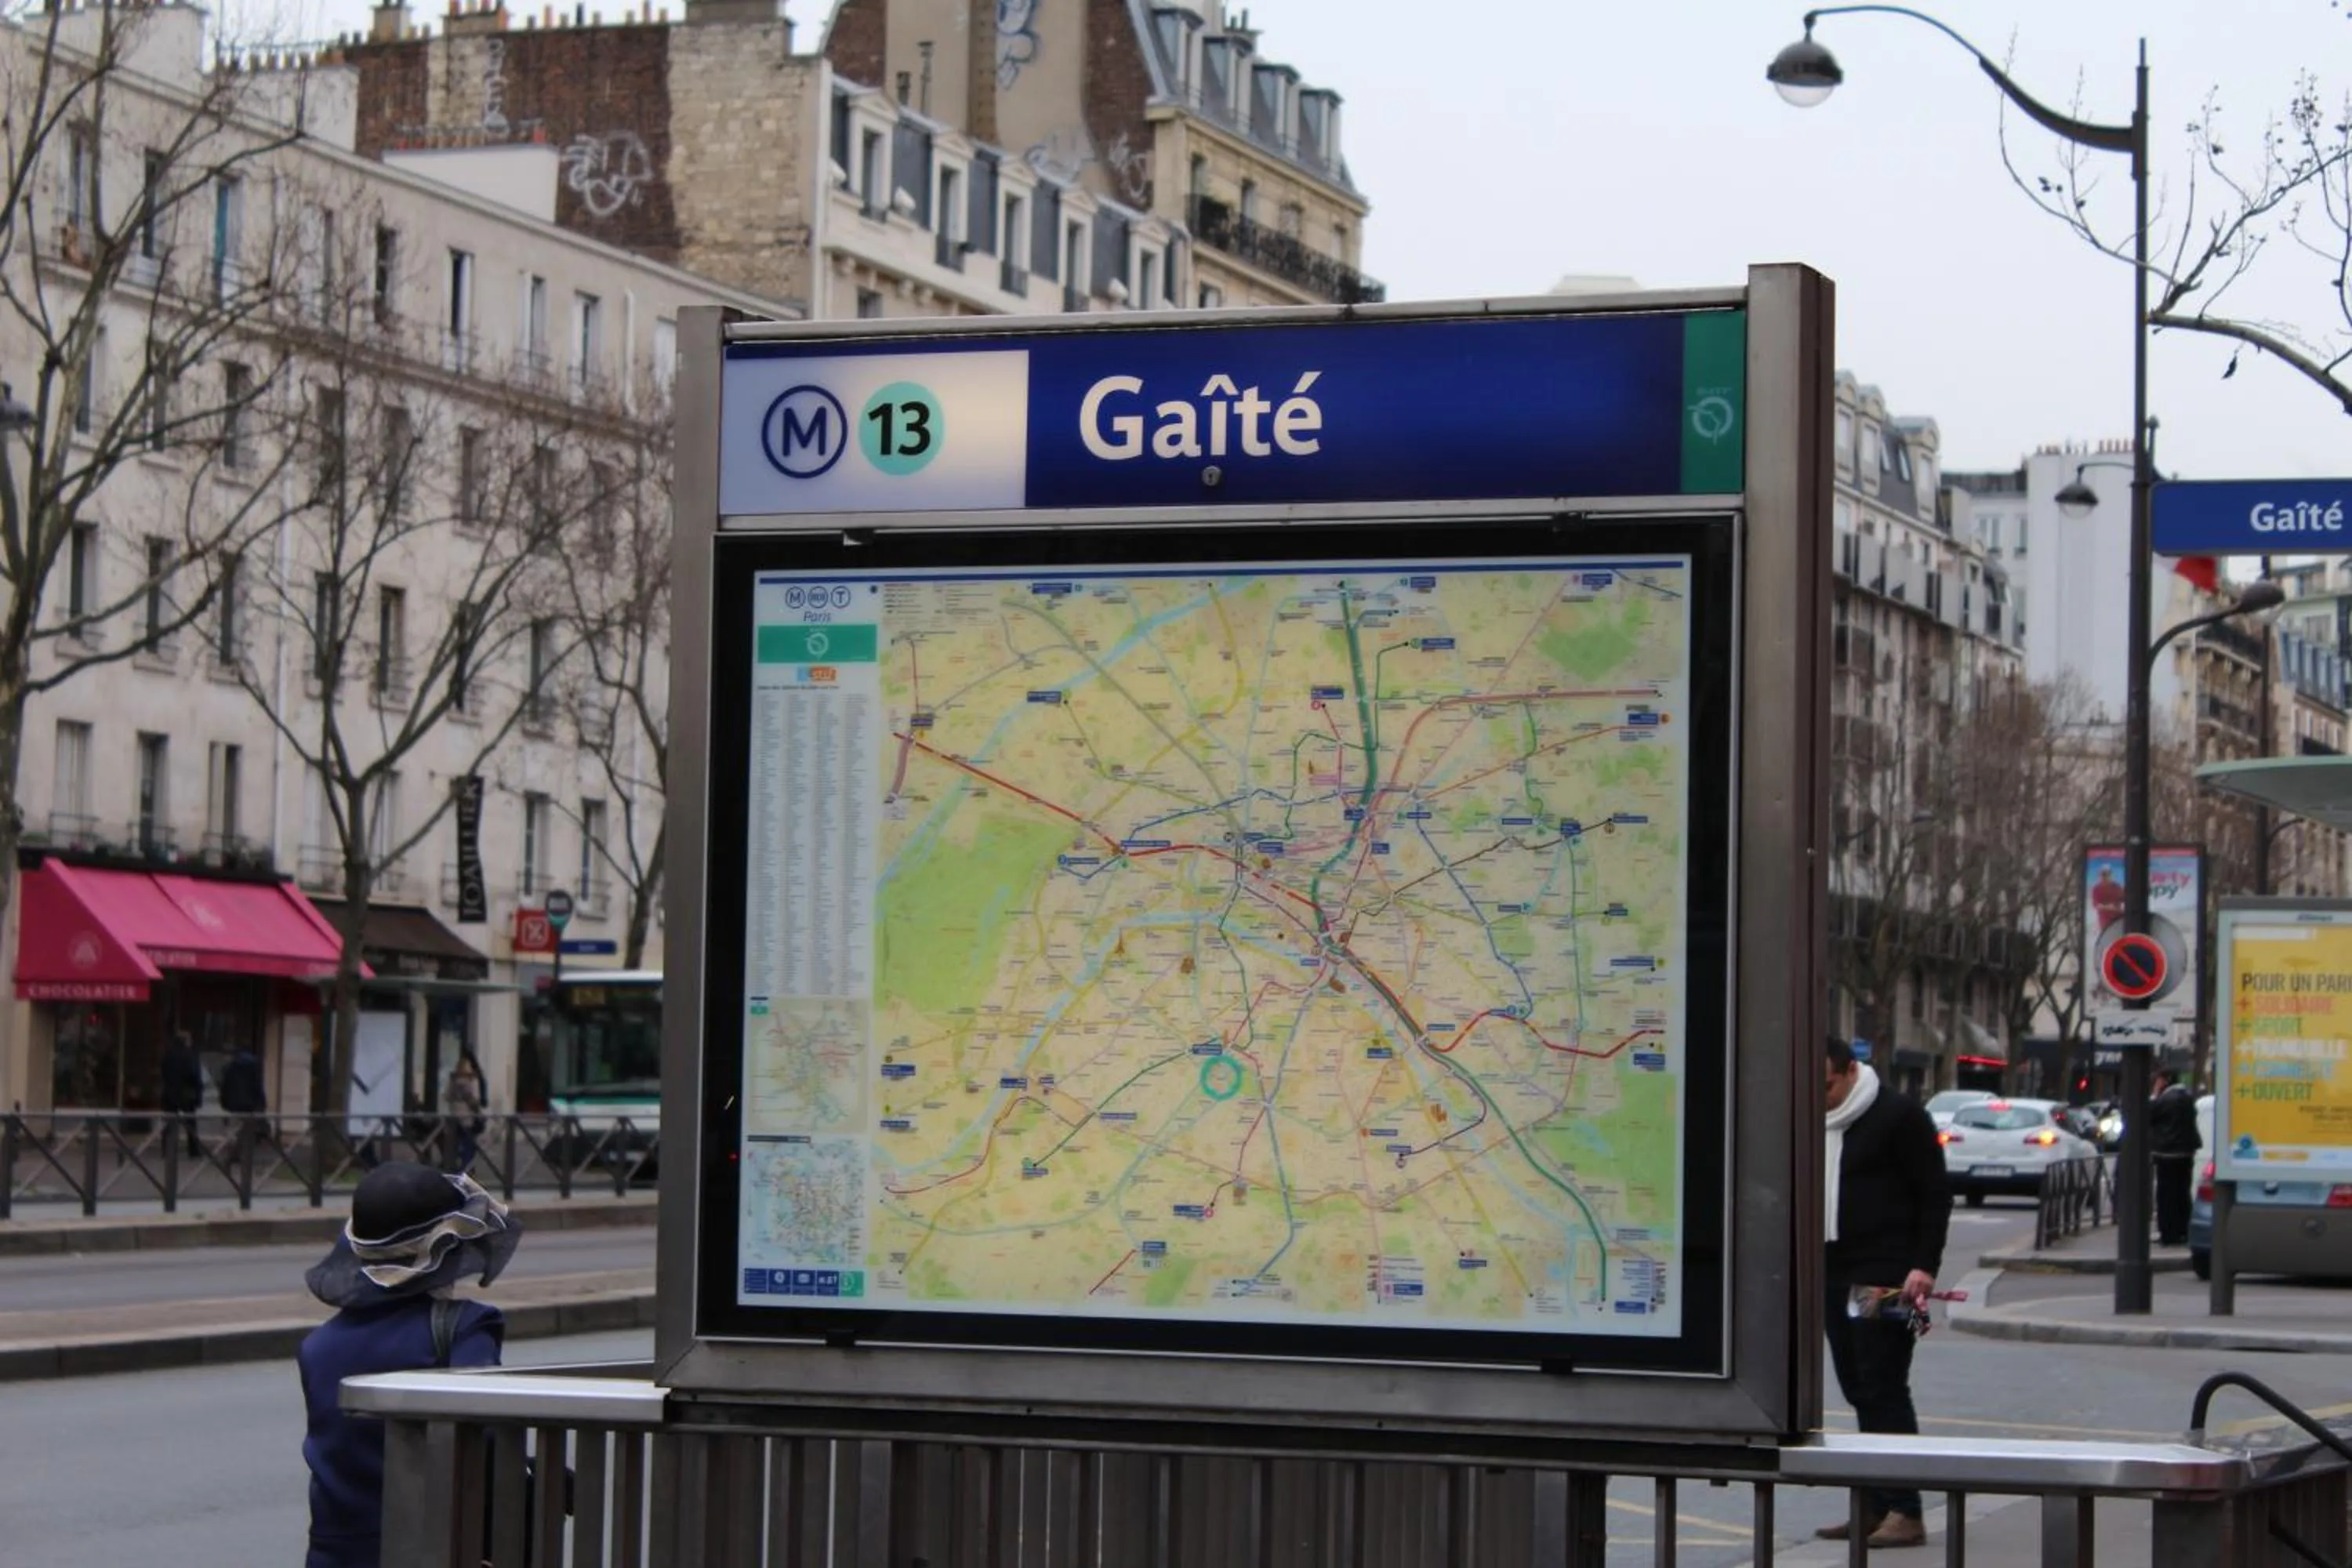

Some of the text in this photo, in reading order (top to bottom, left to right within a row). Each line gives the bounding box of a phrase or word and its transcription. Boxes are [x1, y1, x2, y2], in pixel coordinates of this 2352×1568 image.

[782, 371, 1323, 461] M 13 Gaîté
[2249, 499, 2343, 532] Gaîté
[803, 611, 832, 622] Paris
[27, 983, 136, 999] CHOCOLATIER
[2242, 972, 2285, 992] POUR
[2290, 973, 2312, 992] UN
[2252, 1082, 2314, 1102] OUVERT
